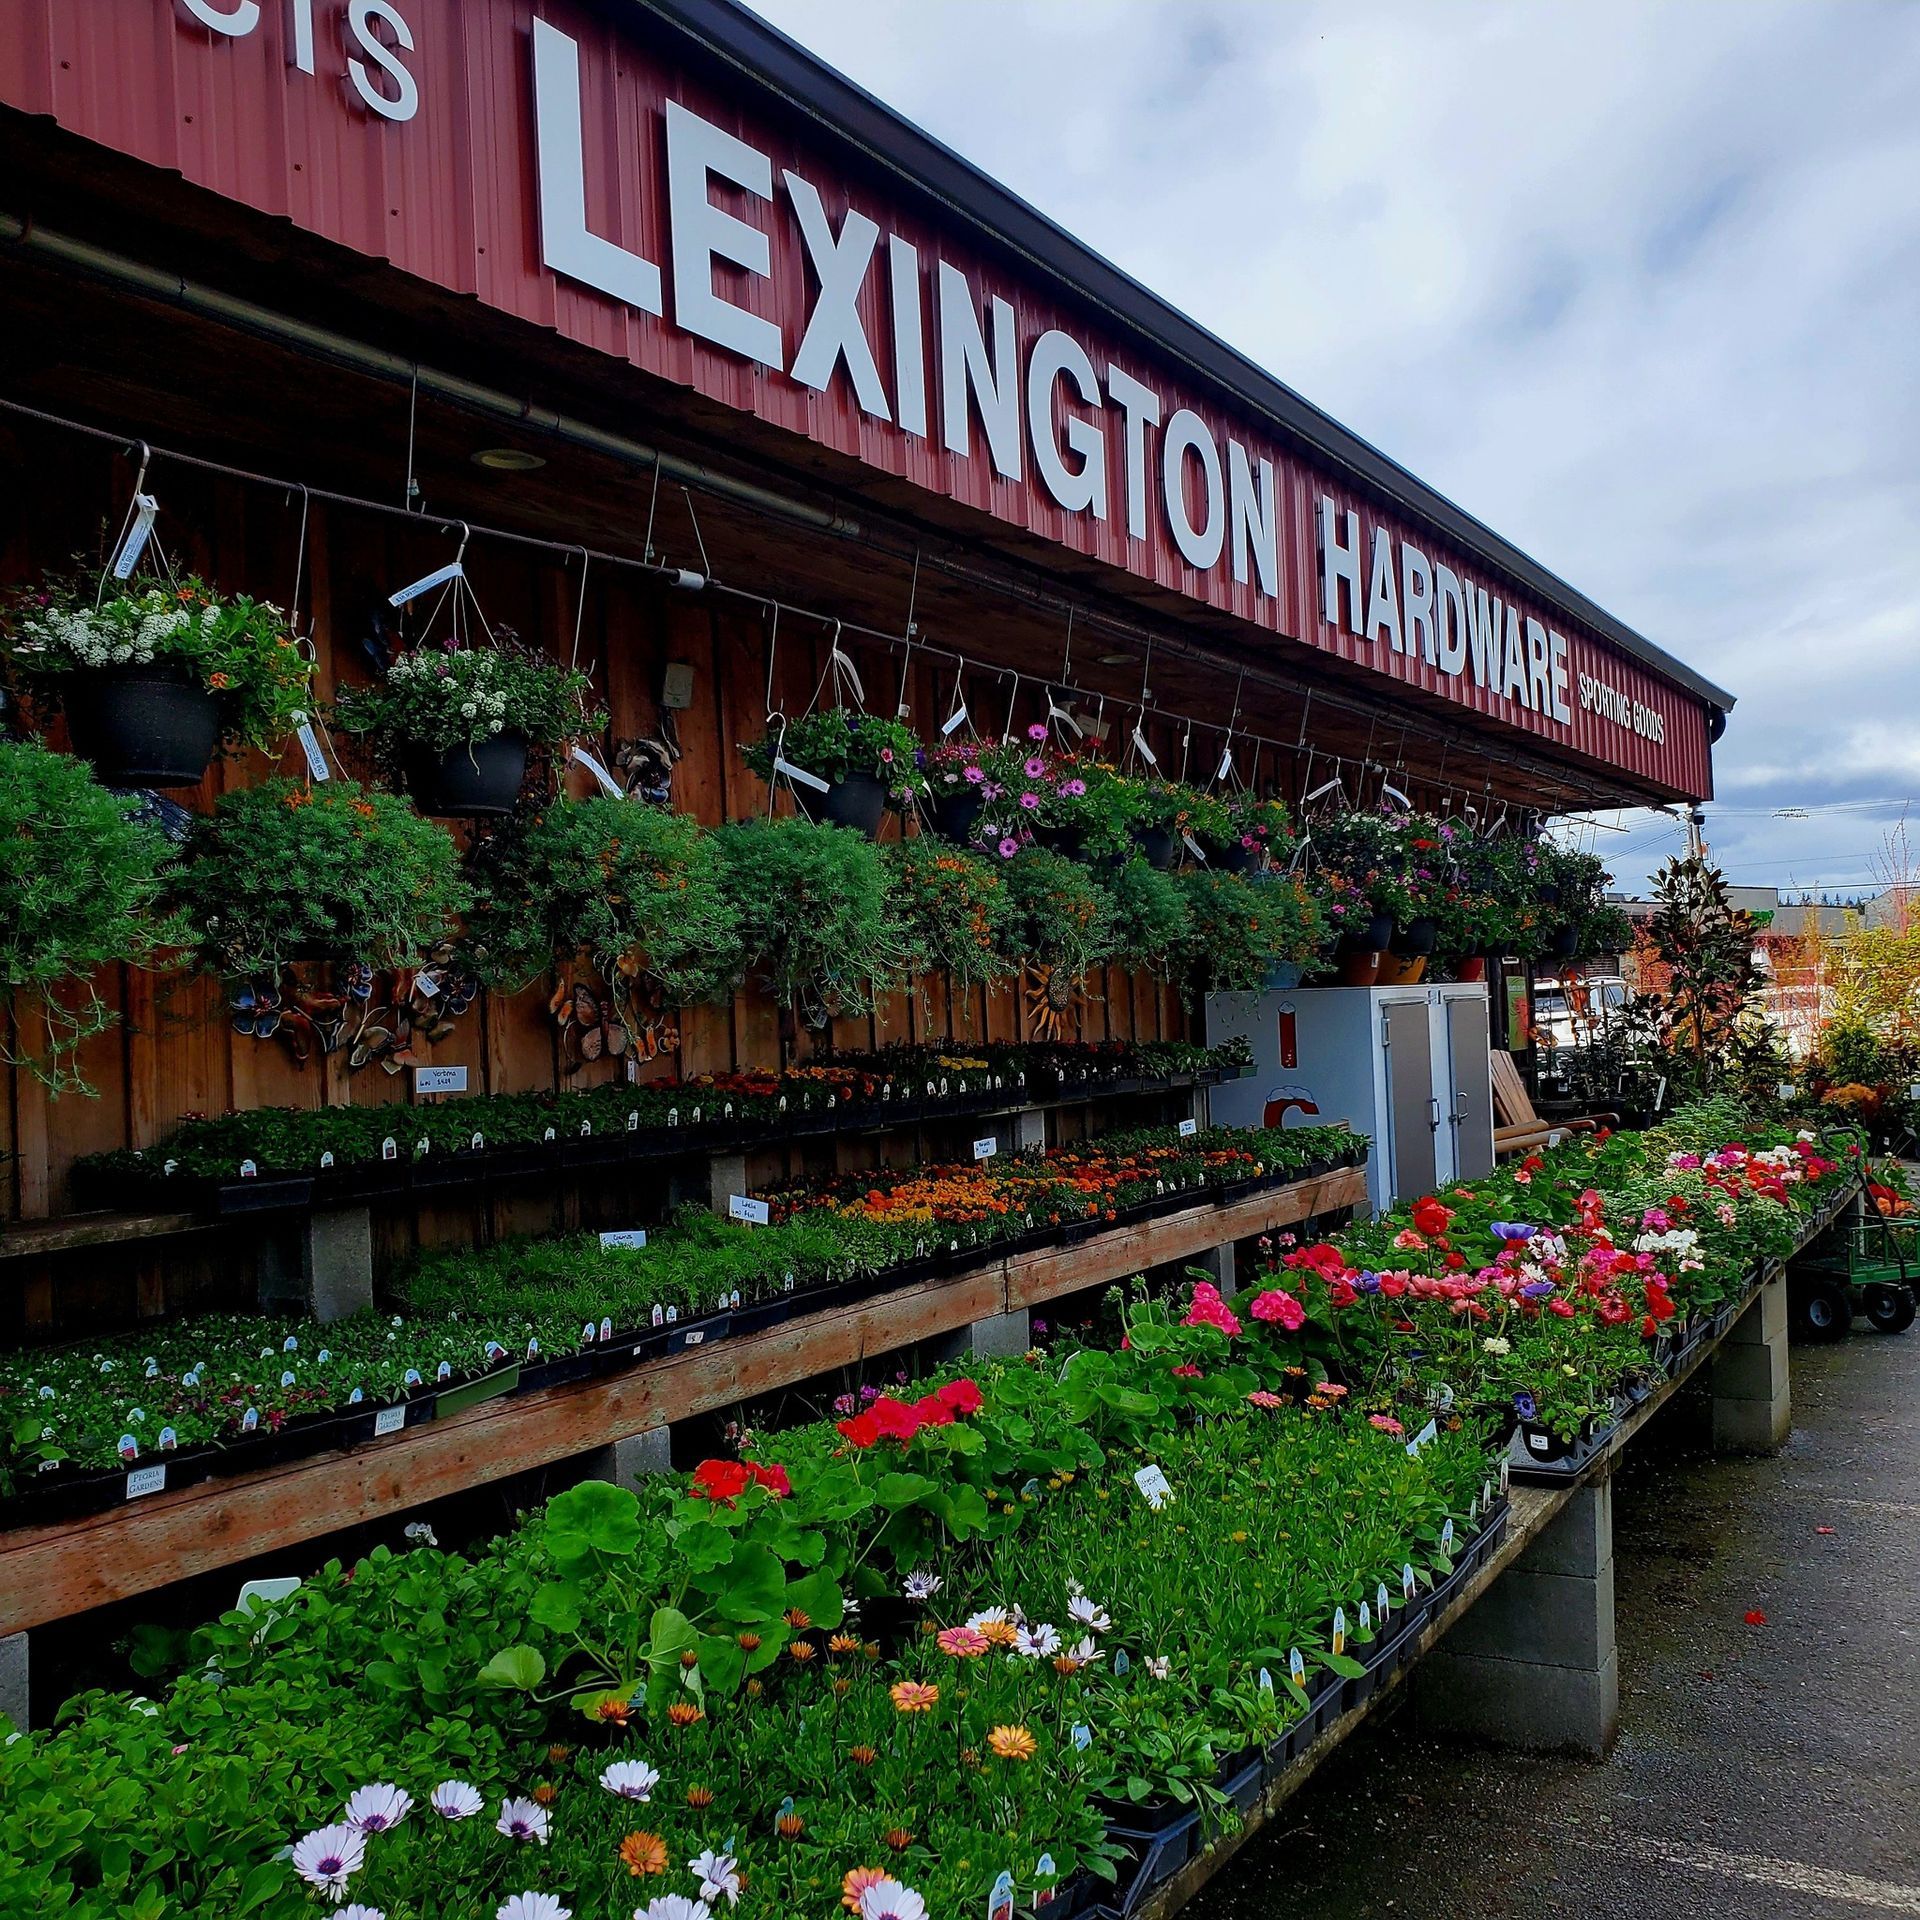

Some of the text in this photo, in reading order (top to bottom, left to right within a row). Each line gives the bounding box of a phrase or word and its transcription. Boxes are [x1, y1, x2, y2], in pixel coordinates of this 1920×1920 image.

[532, 16, 1278, 598] LEXINGTON
[1322, 494, 1571, 726] HARDWARE
[1579, 672, 1664, 745] SPORTING GOODS
[129, 1479, 162, 1493] GARDENS
[133, 1470, 160, 1482] PEORIA
